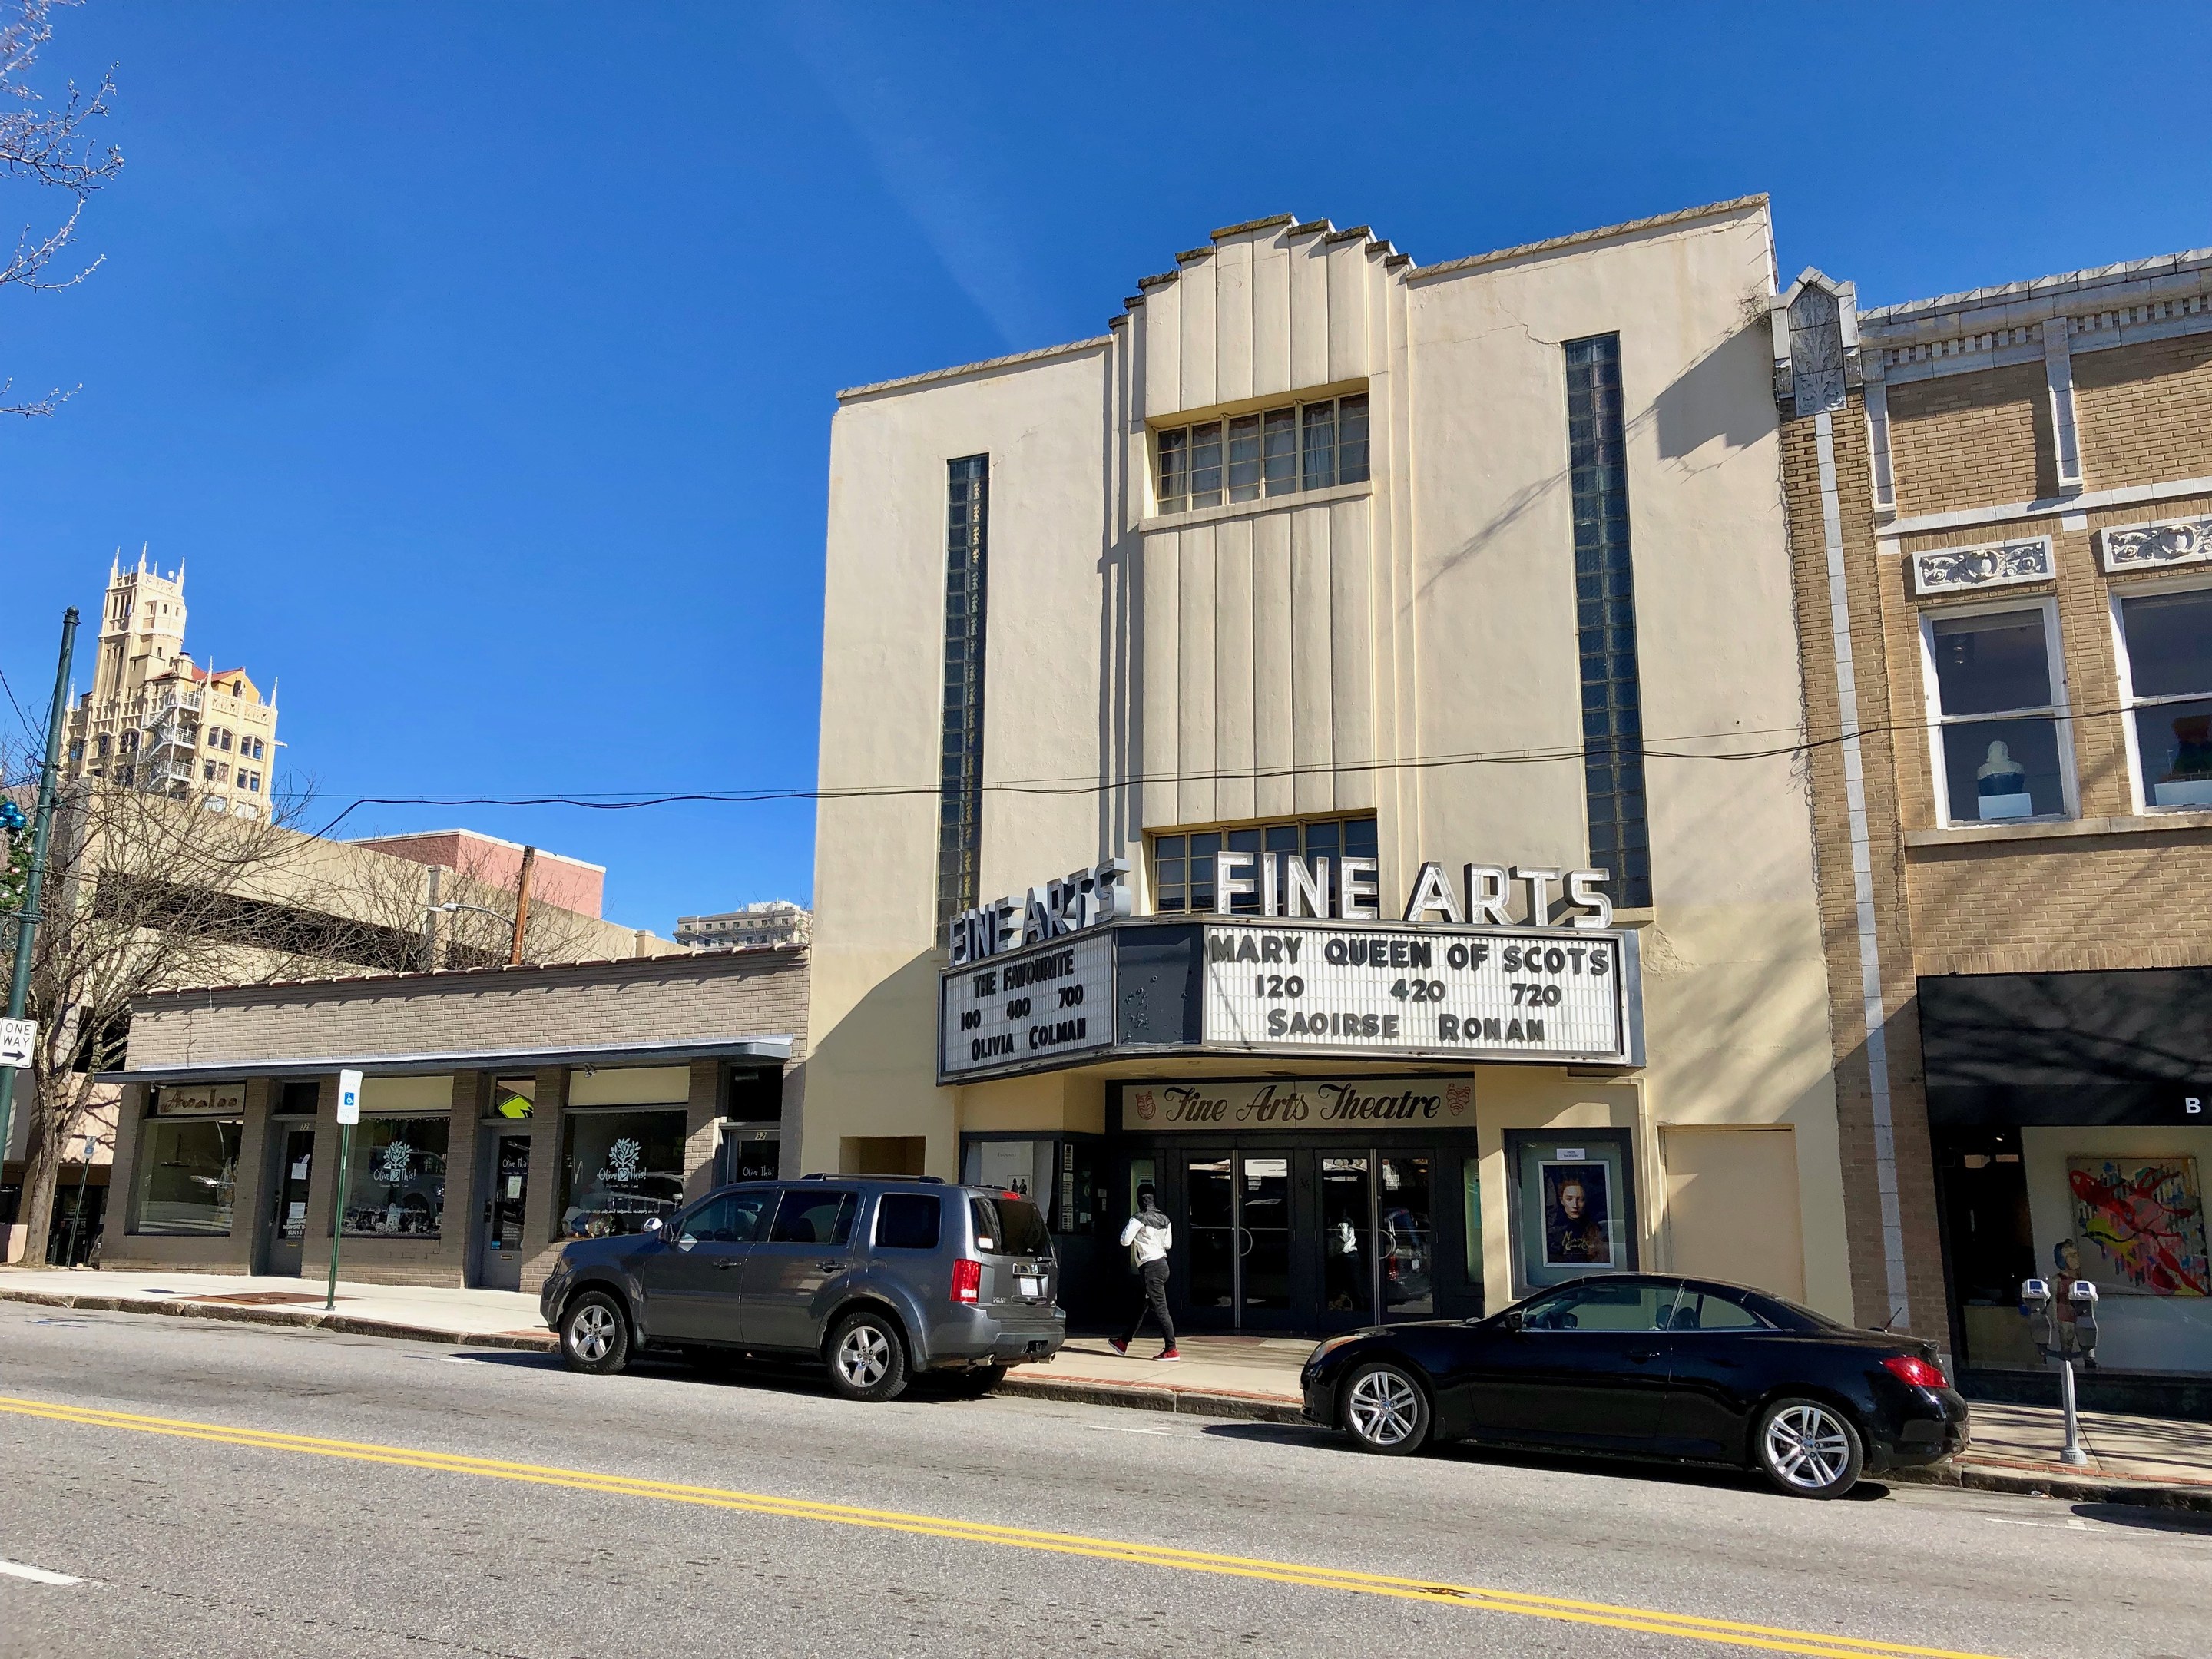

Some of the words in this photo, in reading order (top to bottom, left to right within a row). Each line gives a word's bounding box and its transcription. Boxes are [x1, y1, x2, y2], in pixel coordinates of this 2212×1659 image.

[1214, 851, 1379, 921] FINE
[1402, 861, 1613, 929] ARTS
[949, 896, 1024, 967] FINE
[1022, 857, 1131, 948] ARTS
[1210, 935, 1303, 964] MARY
[1323, 938, 1432, 969] QUEEN
[1446, 942, 1489, 971] OF
[1503, 945, 1610, 976] SCOTS
[973, 971, 997, 998] THE
[1003, 949, 1075, 992] FAVOURITE
[1257, 974, 1305, 998] 120
[1389, 978, 1446, 1002] 420
[1512, 982, 1562, 1006] 720
[960, 1008, 982, 1031] 100
[1006, 997, 1031, 1021] 400
[1058, 984, 1084, 1009] 700
[3, 1035, 31, 1048] WAY
[5, 1022, 31, 1035] ONE
[971, 1033, 1014, 1061] OLIVIA
[1028, 1018, 1086, 1050] COLMAN
[1267, 1008, 1399, 1038] SAOIRSE
[1439, 1013, 1545, 1042] RONAN
[1164, 1086, 1228, 1122] Fine
[1235, 1084, 1310, 1122] Arts
[1317, 1083, 1442, 1120] Theatre
[2185, 1098, 2201, 1114] B
[755, 1131, 767, 1140] 32
[373, 1168, 389, 1181] Olive
[401, 1167, 416, 1181] This!
[598, 1167, 618, 1181] Olive
[630, 1165, 647, 1181] This!
[743, 1166, 759, 1177] Olive
[760, 1164, 774, 1177] This!
